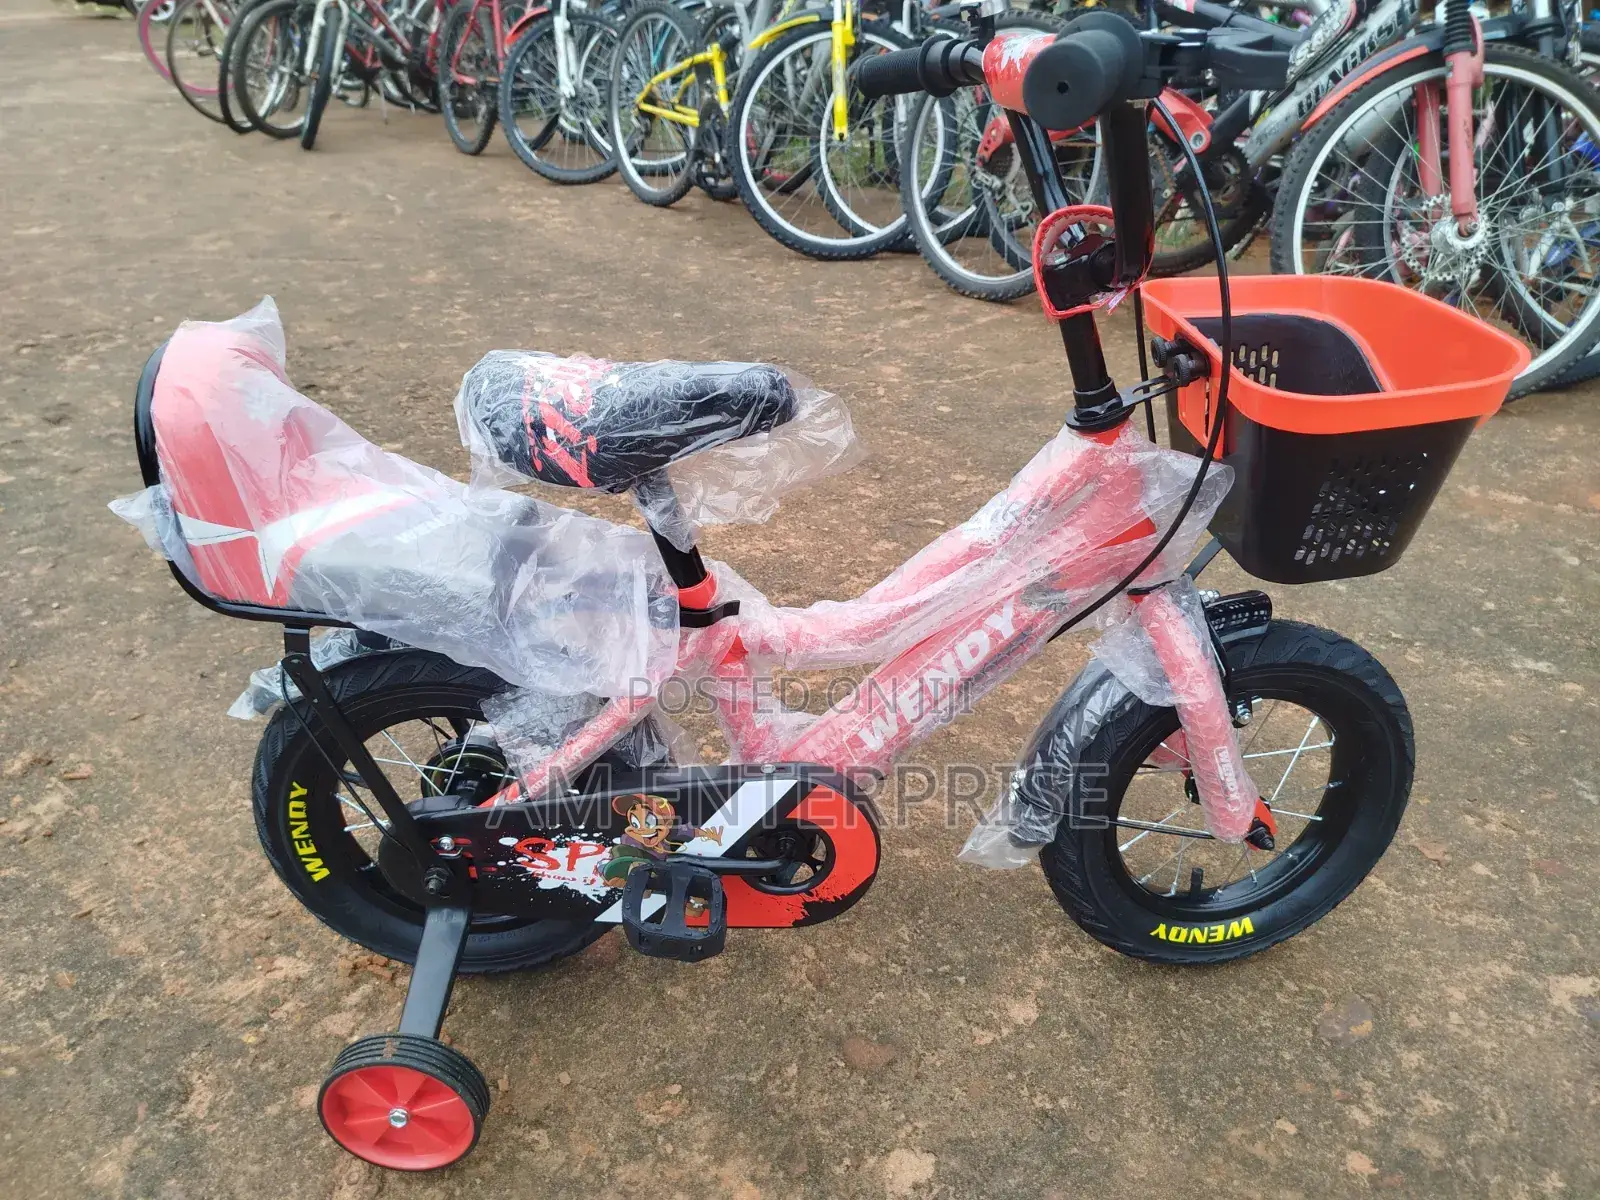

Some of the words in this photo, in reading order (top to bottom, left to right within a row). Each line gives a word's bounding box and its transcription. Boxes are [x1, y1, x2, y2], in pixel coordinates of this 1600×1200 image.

[856, 597, 1016, 751] WENDY
[289, 781, 331, 882] WENDY
[1149, 916, 1255, 944] WENDY
